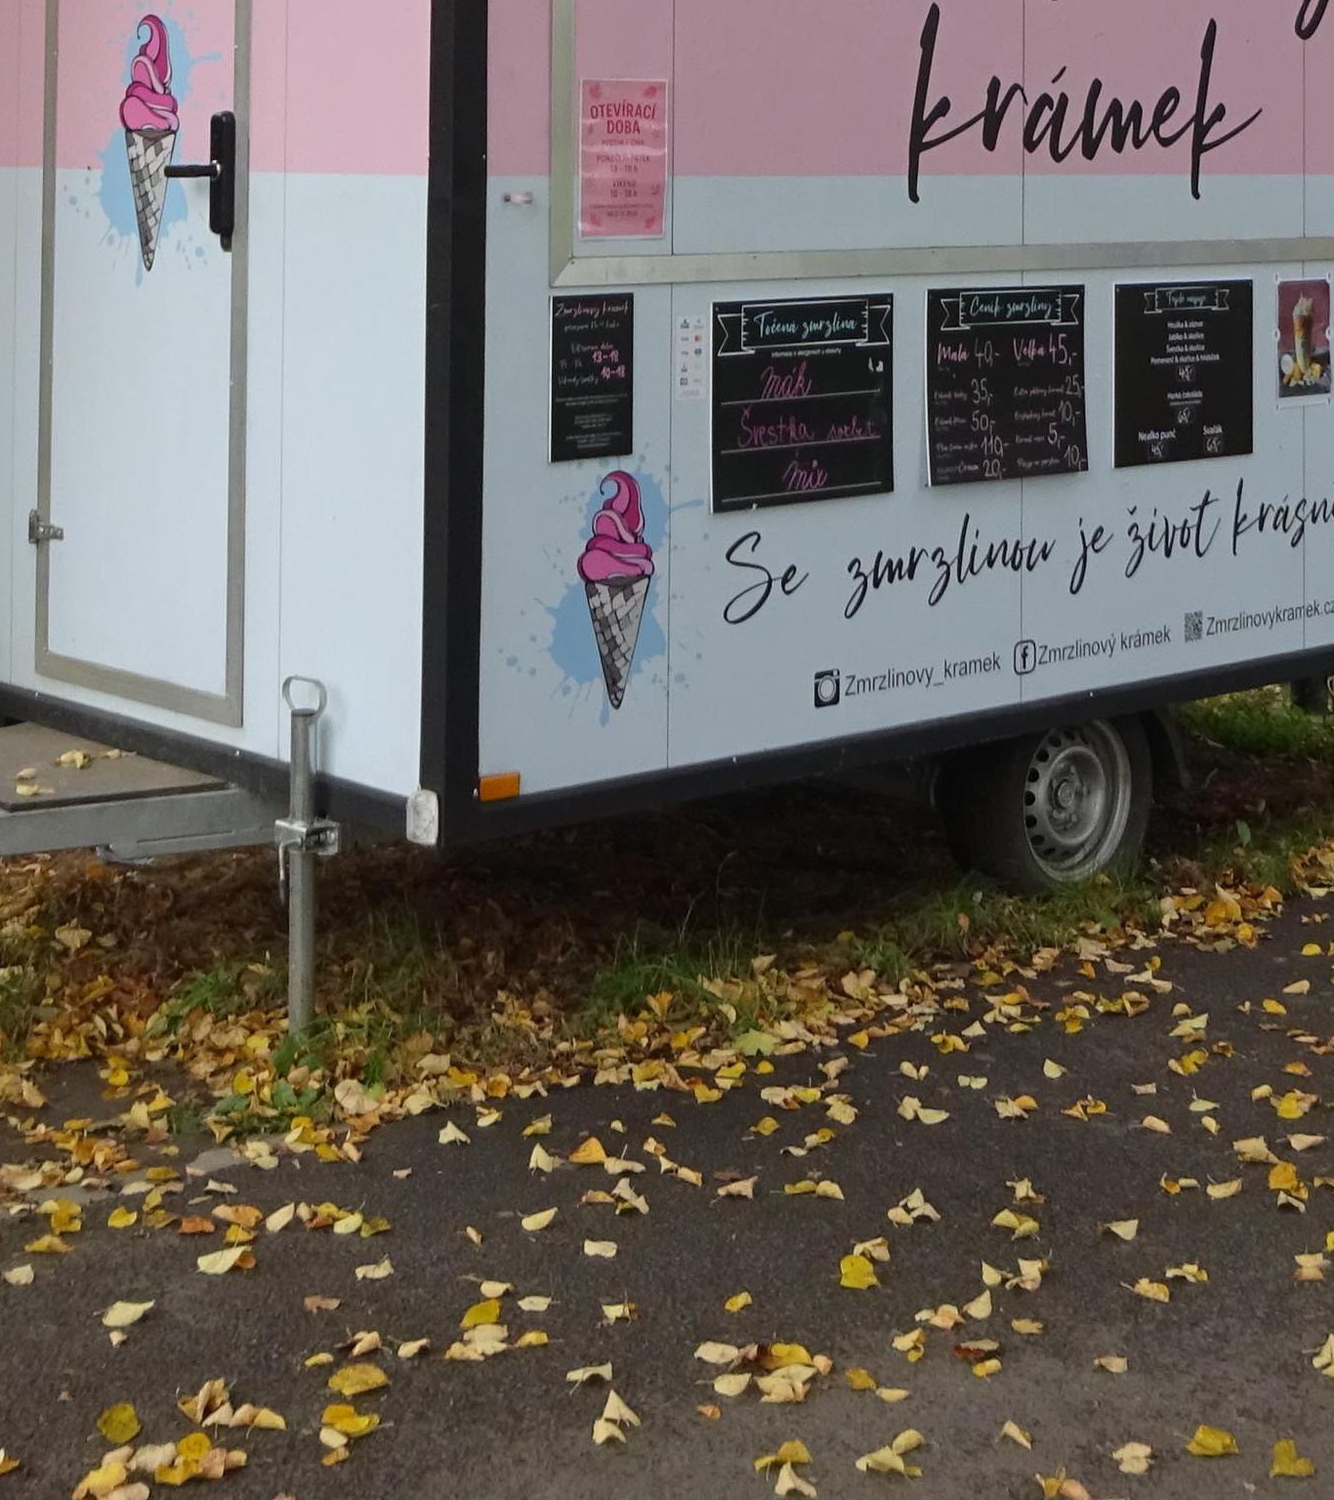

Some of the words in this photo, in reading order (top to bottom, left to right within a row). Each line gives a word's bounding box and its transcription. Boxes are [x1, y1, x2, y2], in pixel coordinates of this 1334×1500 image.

[590, 99, 657, 120] OTEVÍRACÍ
[907, 2, 1262, 203] krámek
[606, 120, 641, 135] DOBA
[802, 311, 857, 339] zmrzlina
[723, 531, 809, 624] Se
[844, 512, 1056, 619] zmrzlinou
[1069, 517, 1114, 595] je
[1125, 489, 1220, 578] život
[1037, 637, 1116, 665] Zmrzlinový
[1120, 624, 1171, 650] krámek
[844, 651, 1001, 696] Zmrzlinovy_kramek
